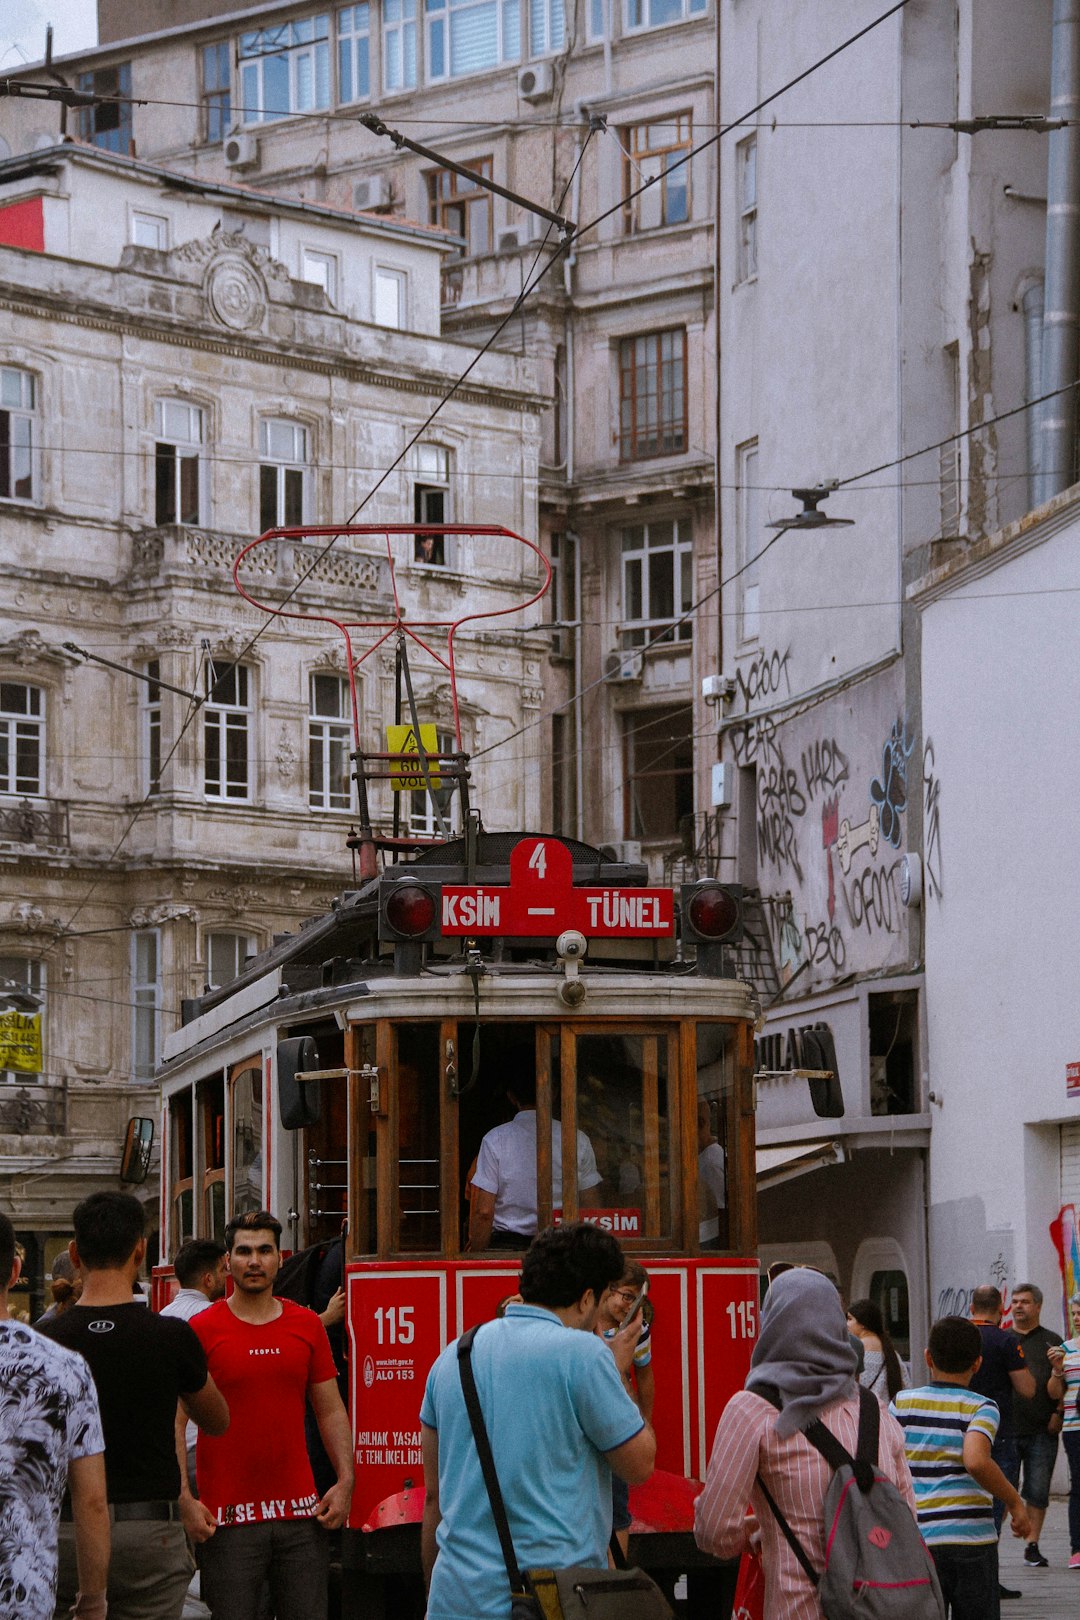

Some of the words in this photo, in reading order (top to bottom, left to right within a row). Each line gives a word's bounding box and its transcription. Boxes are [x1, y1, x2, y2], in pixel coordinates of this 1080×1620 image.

[399, 777, 432, 787] VOL
[758, 766, 806, 817] GRAB
[528, 842, 547, 879] 4
[586, 890, 669, 928] TÜNEL
[374, 1306, 415, 1345] 115
[726, 1300, 756, 1339] 115
[249, 1347, 281, 1356] PEOPLE
[376, 1370, 394, 1381] ALO
[396, 1369, 415, 1380] 153
[260, 1500, 286, 1520] MY
